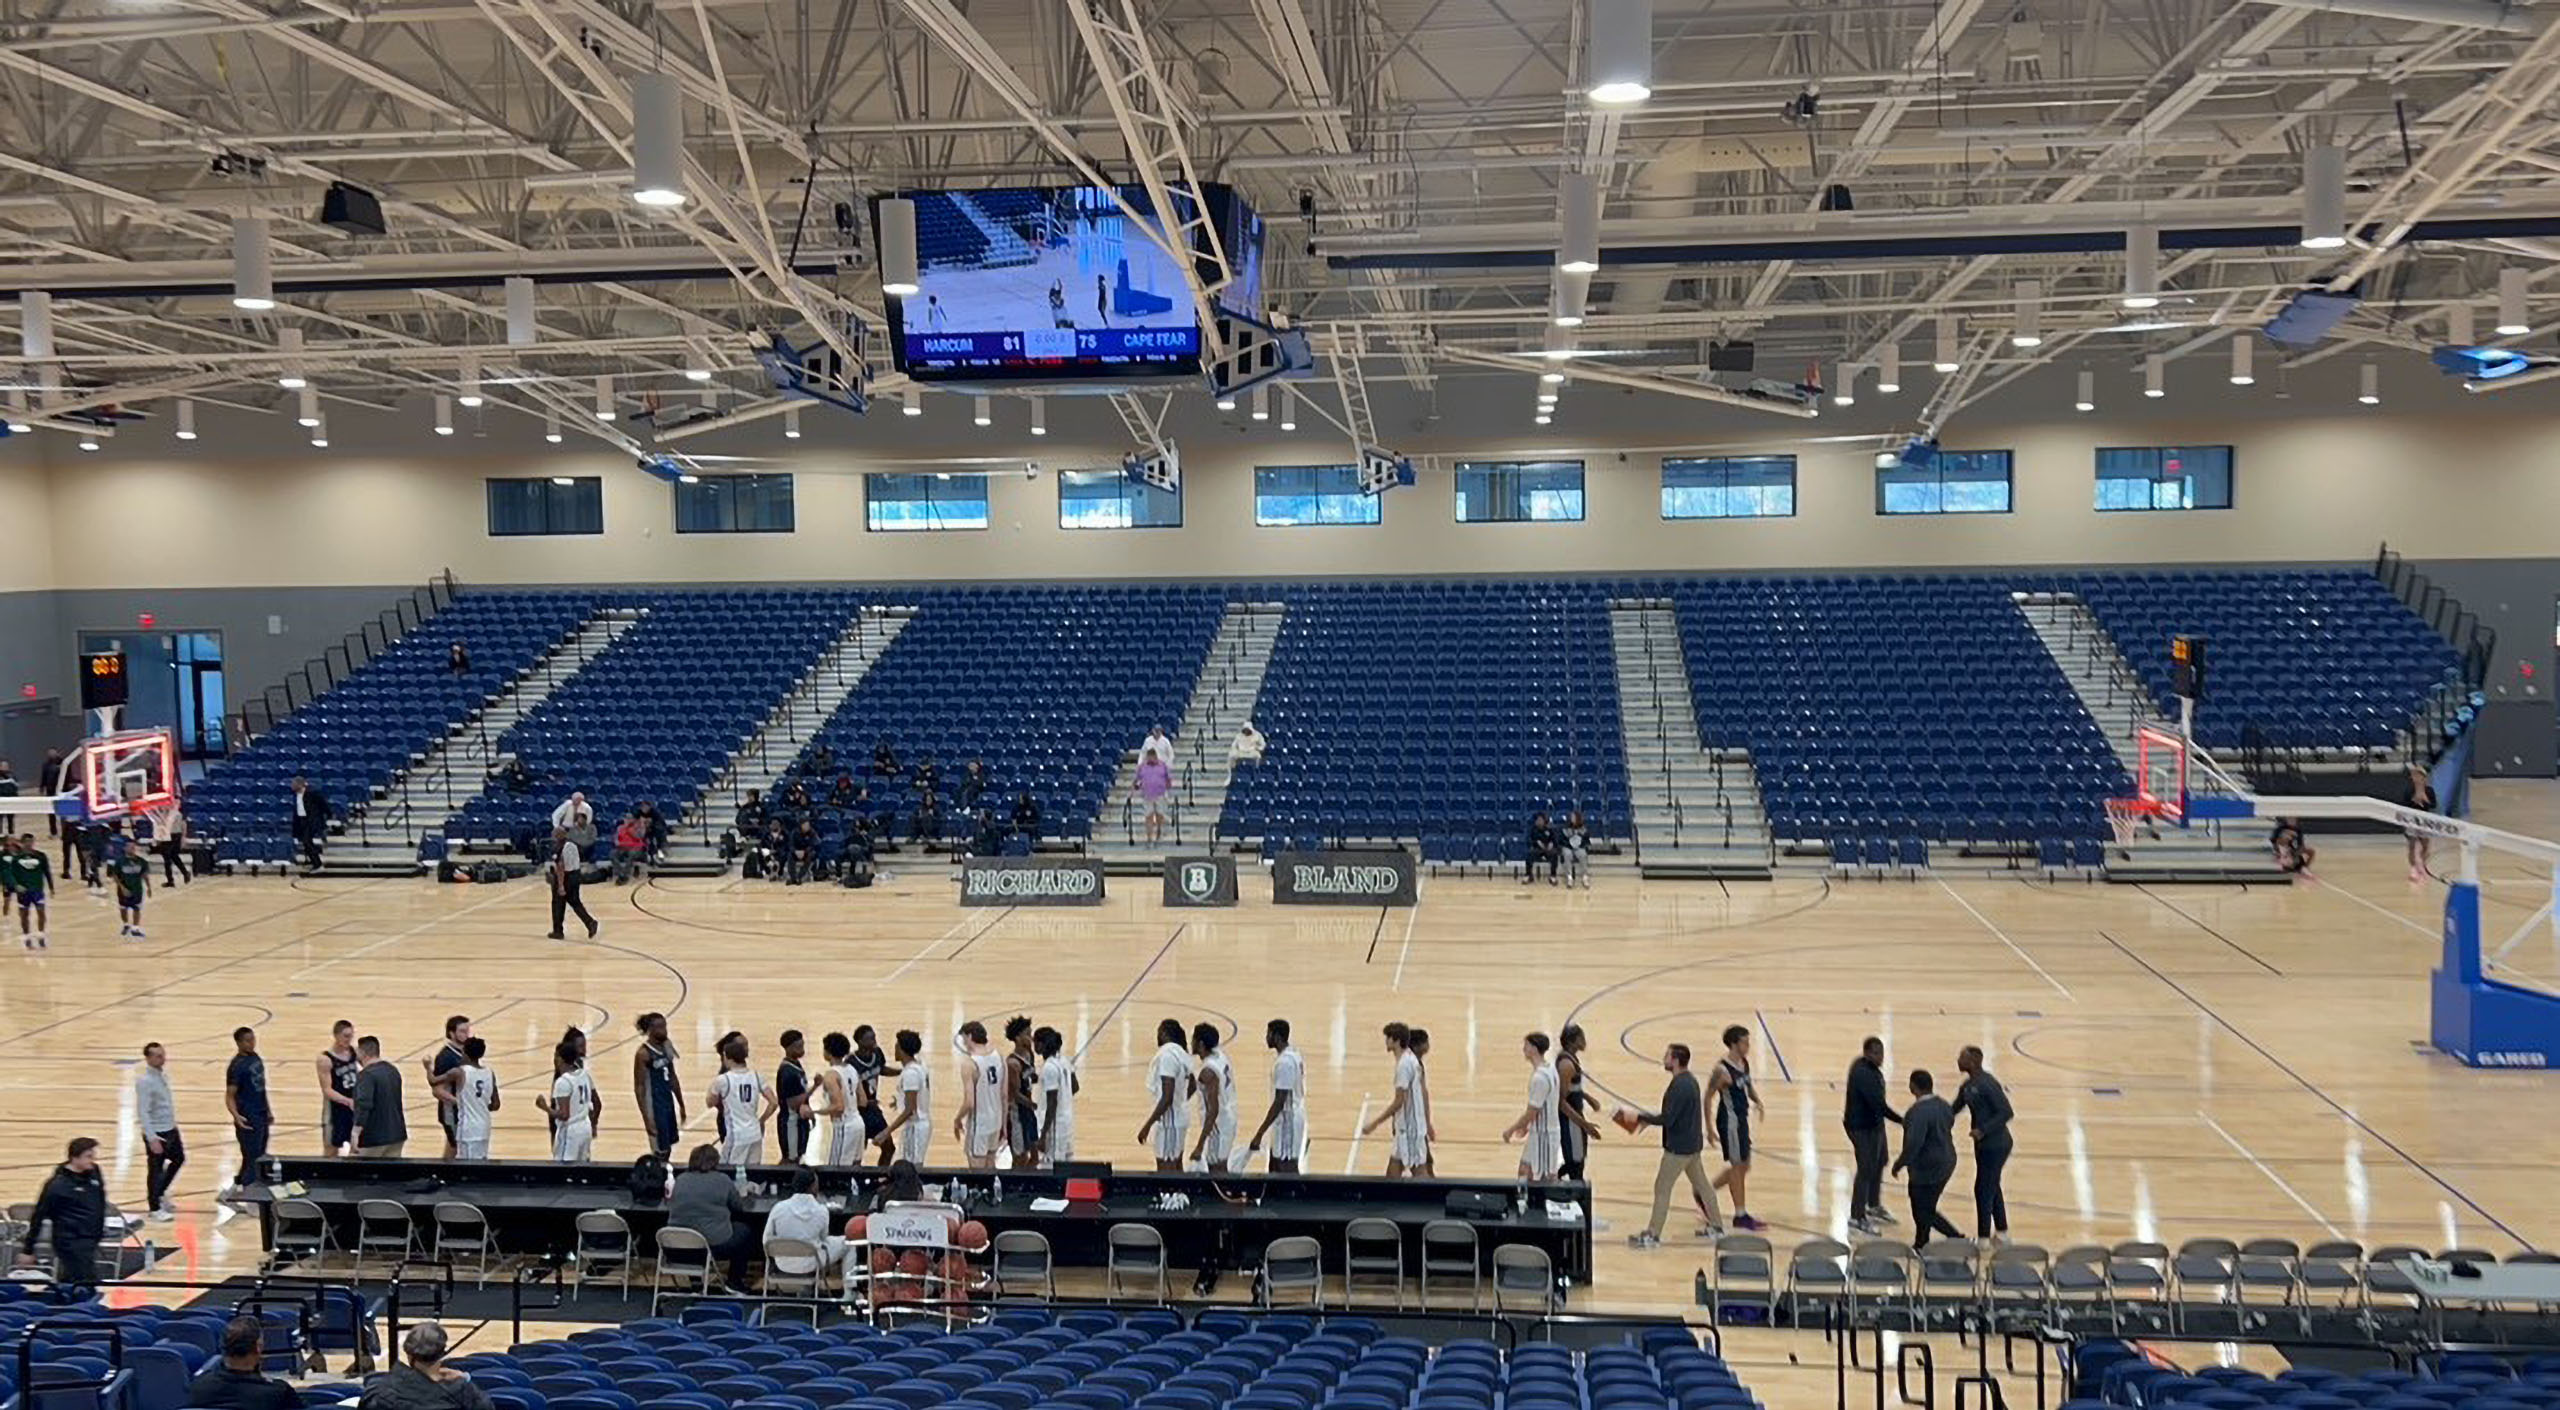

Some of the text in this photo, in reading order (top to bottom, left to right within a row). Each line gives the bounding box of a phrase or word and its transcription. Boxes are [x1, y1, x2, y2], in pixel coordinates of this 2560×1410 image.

[1124, 333, 1154, 347] CAPE
[1156, 332, 1187, 346] FEAR
[967, 869, 1095, 896] RICHARD
[1189, 868, 1208, 891] B
[1293, 865, 1399, 893] BLAND
[739, 1083, 752, 1103] 10
